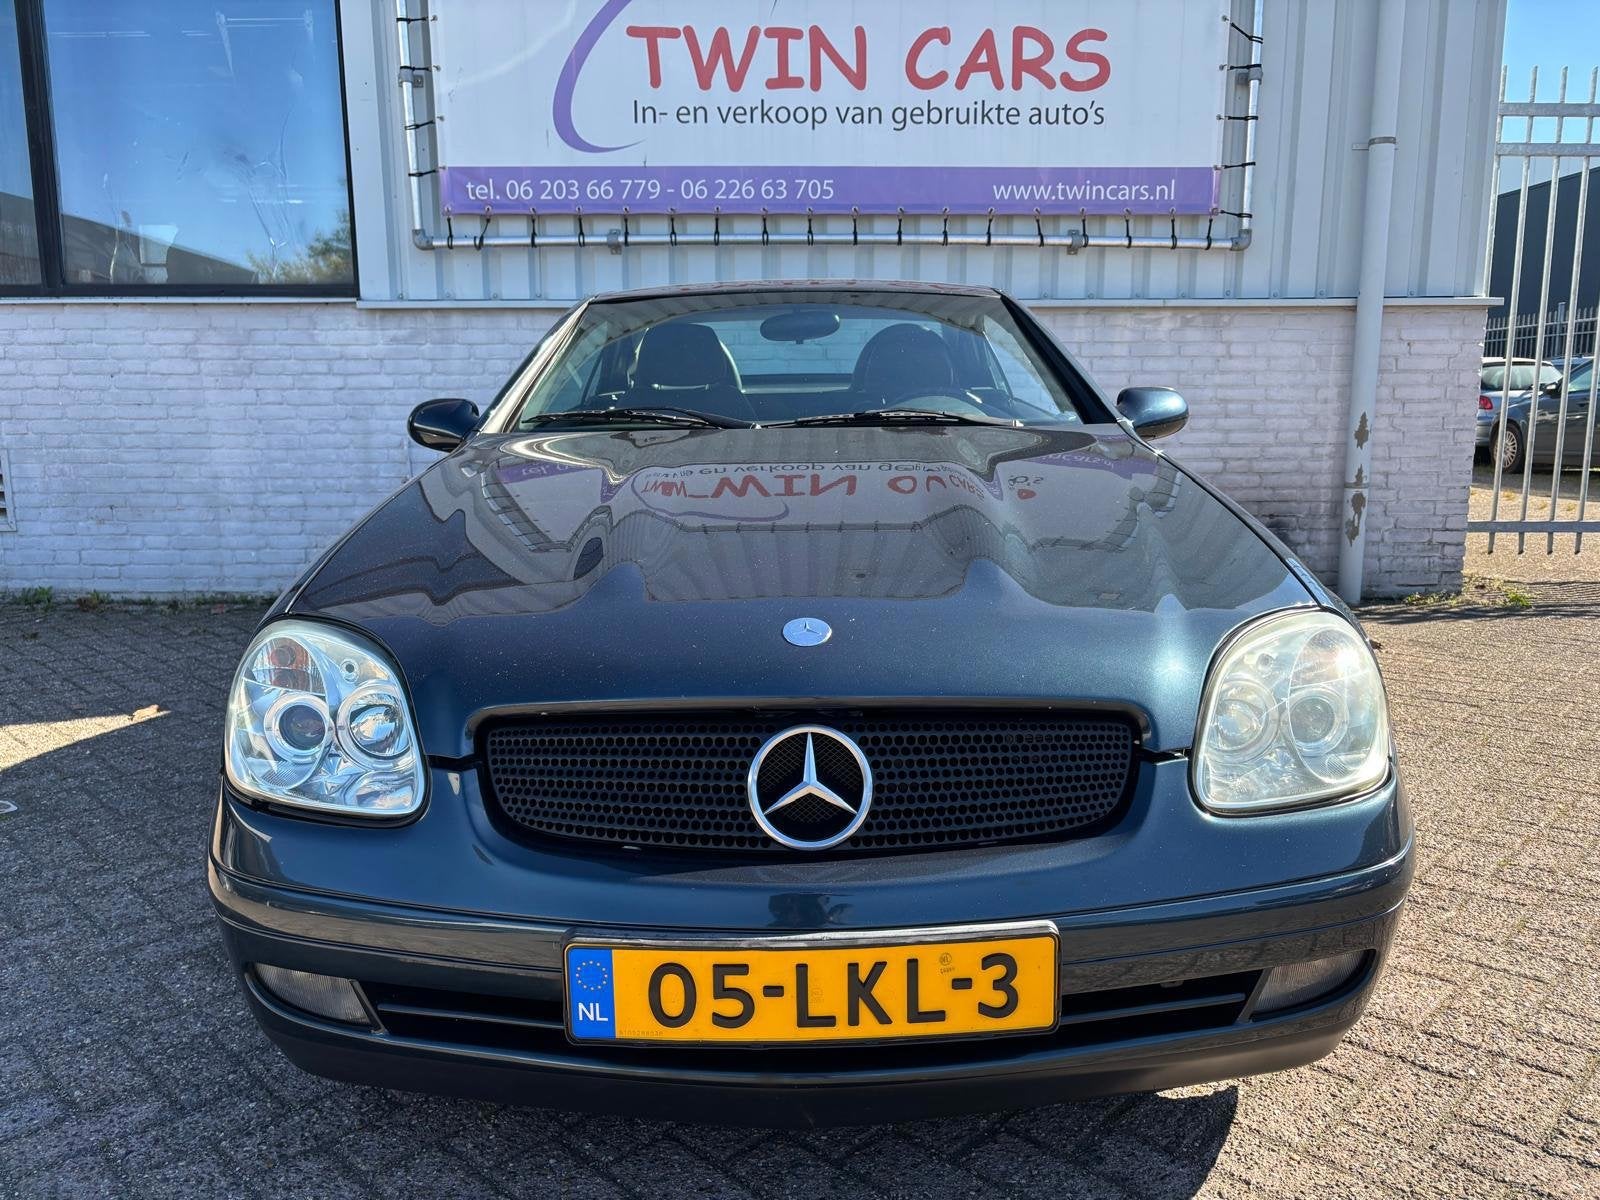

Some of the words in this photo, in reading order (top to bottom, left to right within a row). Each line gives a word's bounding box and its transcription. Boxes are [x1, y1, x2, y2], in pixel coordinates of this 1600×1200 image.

[627, 25, 867, 92] TWIN
[905, 26, 1111, 92] CARS
[634, 99, 668, 124] In-
[676, 106, 708, 124] en
[716, 98, 827, 130] verkoop
[835, 106, 882, 125] van
[891, 99, 1021, 132] gebruikte
[1028, 100, 1105, 125] auto's
[466, 179, 500, 200] tel.
[506, 179, 533, 200] 06
[540, 179, 580, 200] 203
[586, 179, 614, 200] 66
[620, 179, 661, 200] 779
[681, 179, 708, 200] 06
[714, 179, 755, 200] 226
[761, 179, 788, 200] 63
[795, 179, 834, 200] 705
[992, 179, 1176, 202] www.twincars.nl
[647, 952, 1020, 1029] 05-LKL-3
[578, 1002, 609, 1022] NL
